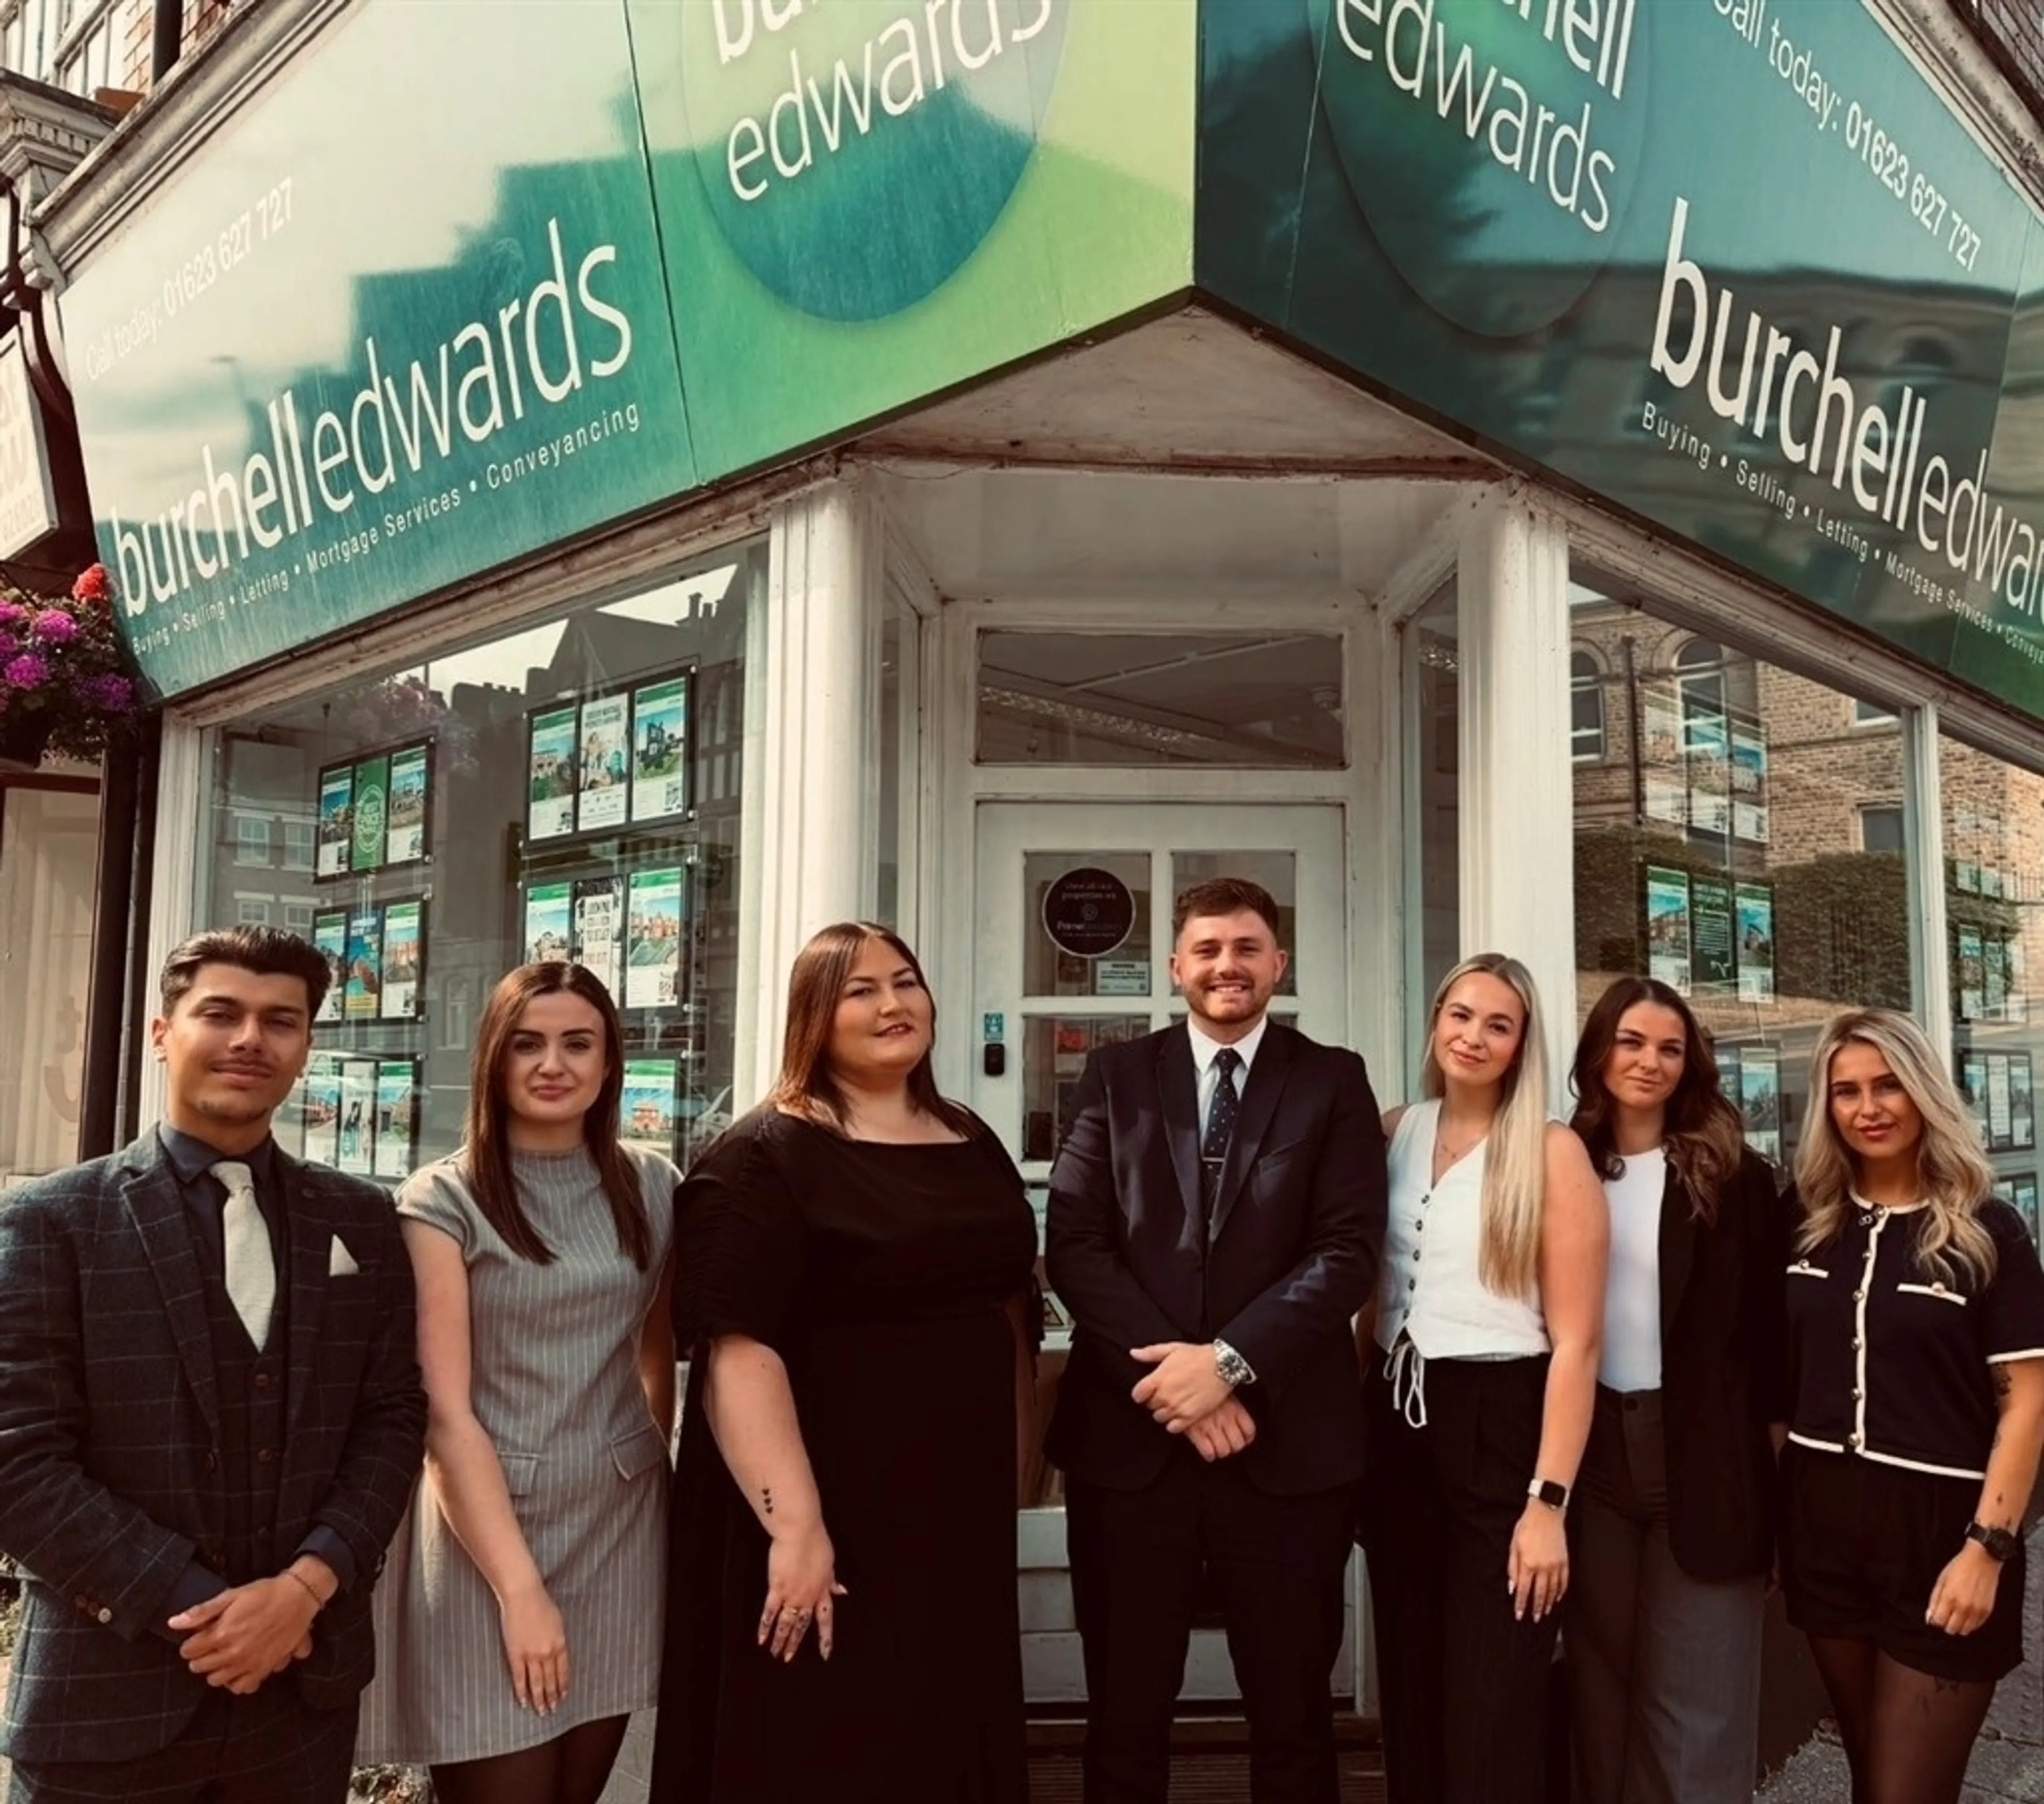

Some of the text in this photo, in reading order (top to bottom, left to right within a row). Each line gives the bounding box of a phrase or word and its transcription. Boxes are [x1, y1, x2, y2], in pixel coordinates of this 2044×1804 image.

[1336, 0, 1615, 233] edwards
[1768, 18, 1842, 131] today:
[1845, 101, 1909, 199] 01623
[1910, 173, 1948, 236] 627
[1948, 210, 1981, 272] 727
[85, 328, 116, 381] Call
[163, 245, 217, 317] 01623
[218, 211, 251, 271] 627
[256, 176, 293, 241] 727
[132, 402, 640, 656] Buying Selling Letting Mortgage Services Conveyancing
[1642, 401, 1711, 470] Buying
[1736, 459, 1796, 520] Selling
[1816, 508, 1869, 562] Letting
[1884, 551, 1943, 603] Mortgage
[1946, 589, 1993, 633] Services
